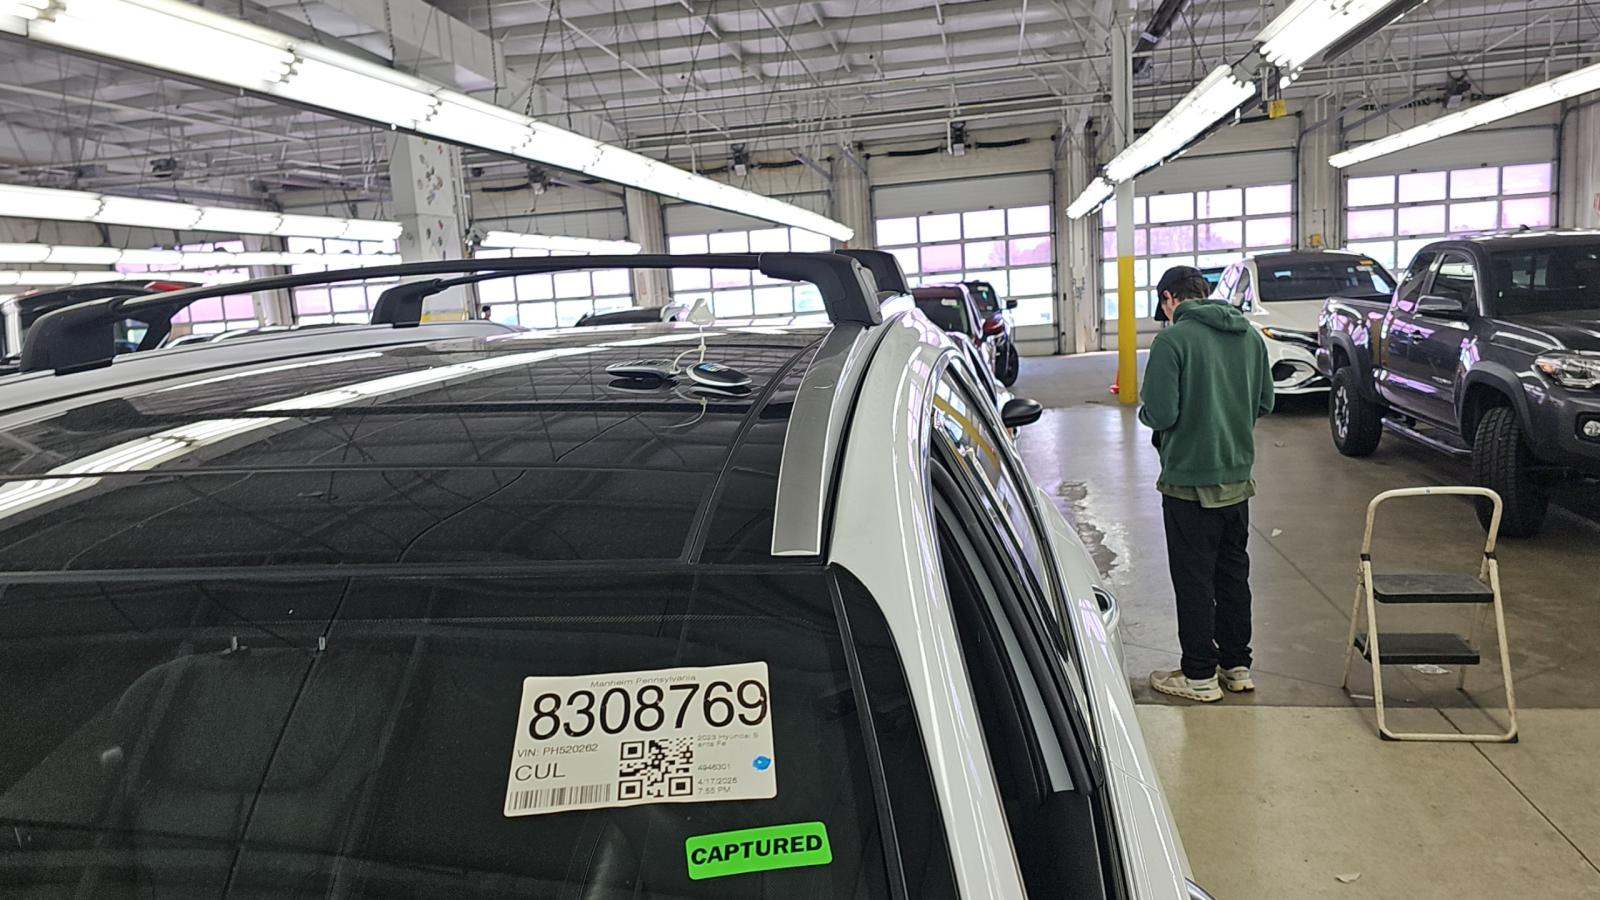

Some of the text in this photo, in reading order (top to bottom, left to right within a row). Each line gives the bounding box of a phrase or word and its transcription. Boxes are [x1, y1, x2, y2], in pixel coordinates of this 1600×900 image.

[590, 674, 697, 688] Manheim Pennsylvania
[528, 679, 768, 741] 8308769
[517, 747, 540, 758] VIN:
[515, 762, 566, 782] CUL
[691, 834, 823, 866] CAPTURED
